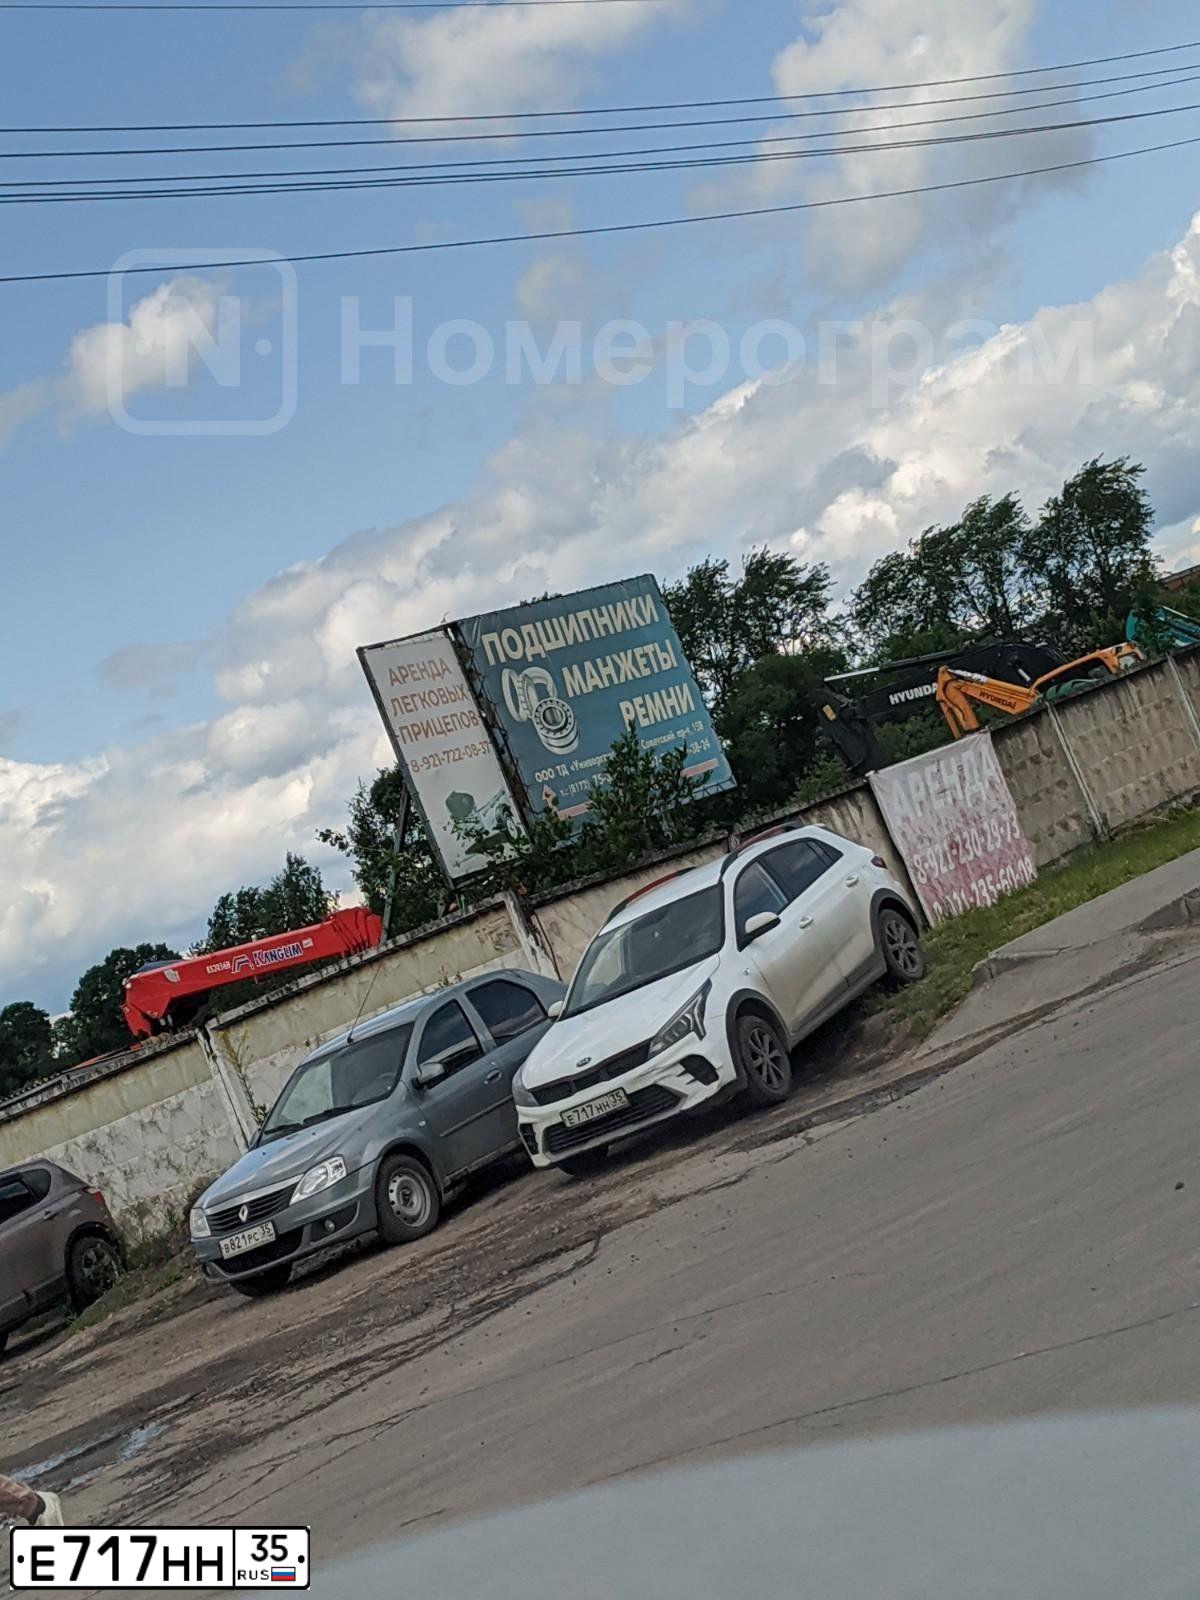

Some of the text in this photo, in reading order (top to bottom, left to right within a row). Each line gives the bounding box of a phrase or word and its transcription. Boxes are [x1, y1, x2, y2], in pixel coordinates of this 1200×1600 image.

[481, 593, 660, 667] ПОДШИПНИКИ
[388, 657, 452, 687] АРЕНДА
[561, 639, 678, 698] МАНЖЕТЫ
[390, 683, 469, 717] ЛЕГКОВЫХ
[619, 682, 696, 732] РЕМНИ
[888, 682, 938, 706] HYUNDA
[978, 690, 1017, 710] HYUNDAI
[398, 709, 480, 745] ПРИЦЕПОВ
[534, 767, 555, 783] ООО
[555, 763, 570, 777] ТД
[252, 942, 304, 967] KANGLIM
